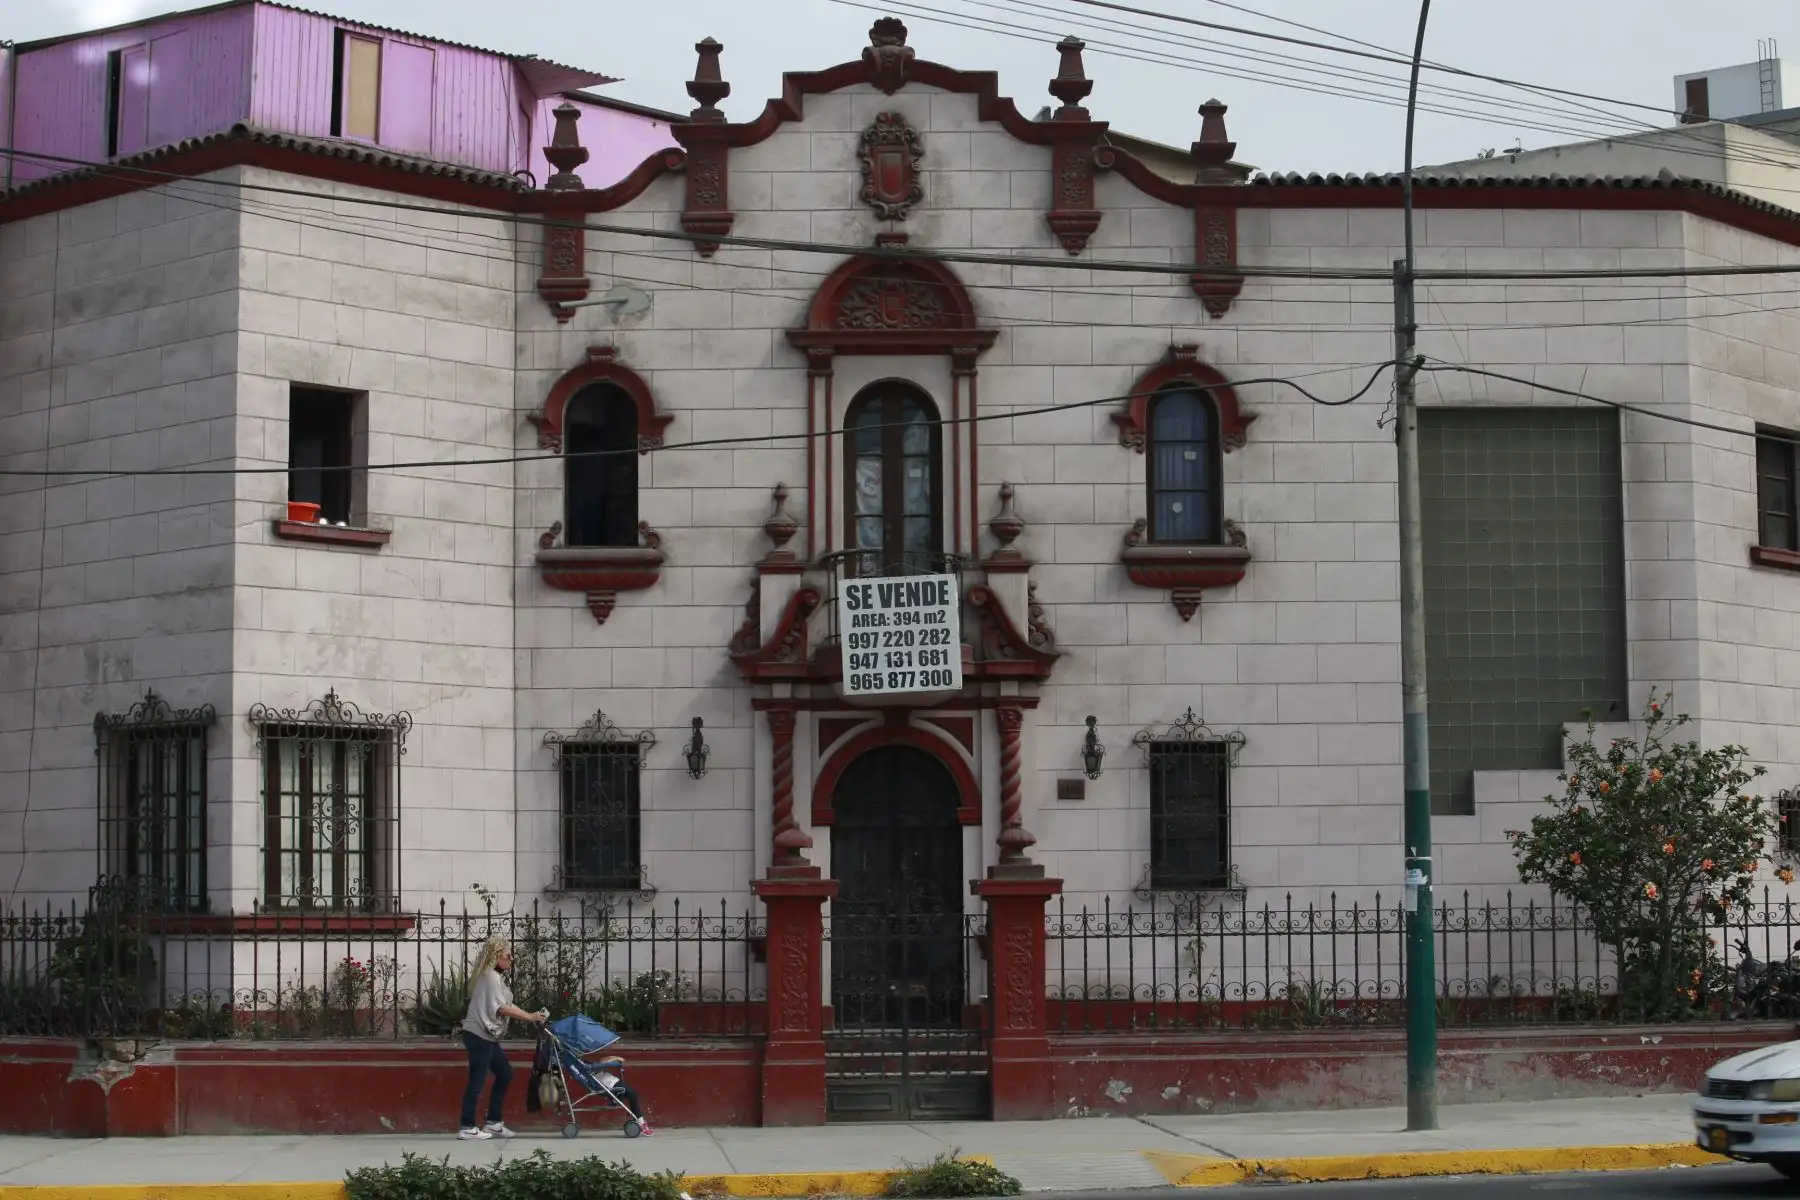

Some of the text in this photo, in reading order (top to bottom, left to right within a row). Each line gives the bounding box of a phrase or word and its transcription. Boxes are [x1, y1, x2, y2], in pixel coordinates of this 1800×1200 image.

[846, 580, 949, 610] SE VENDE
[852, 610, 946, 628] AREA: 394 m2
[848, 628, 951, 649] 997 220 282
[849, 649, 949, 670] 947 131 681
[850, 669, 953, 690] 965 877 300
